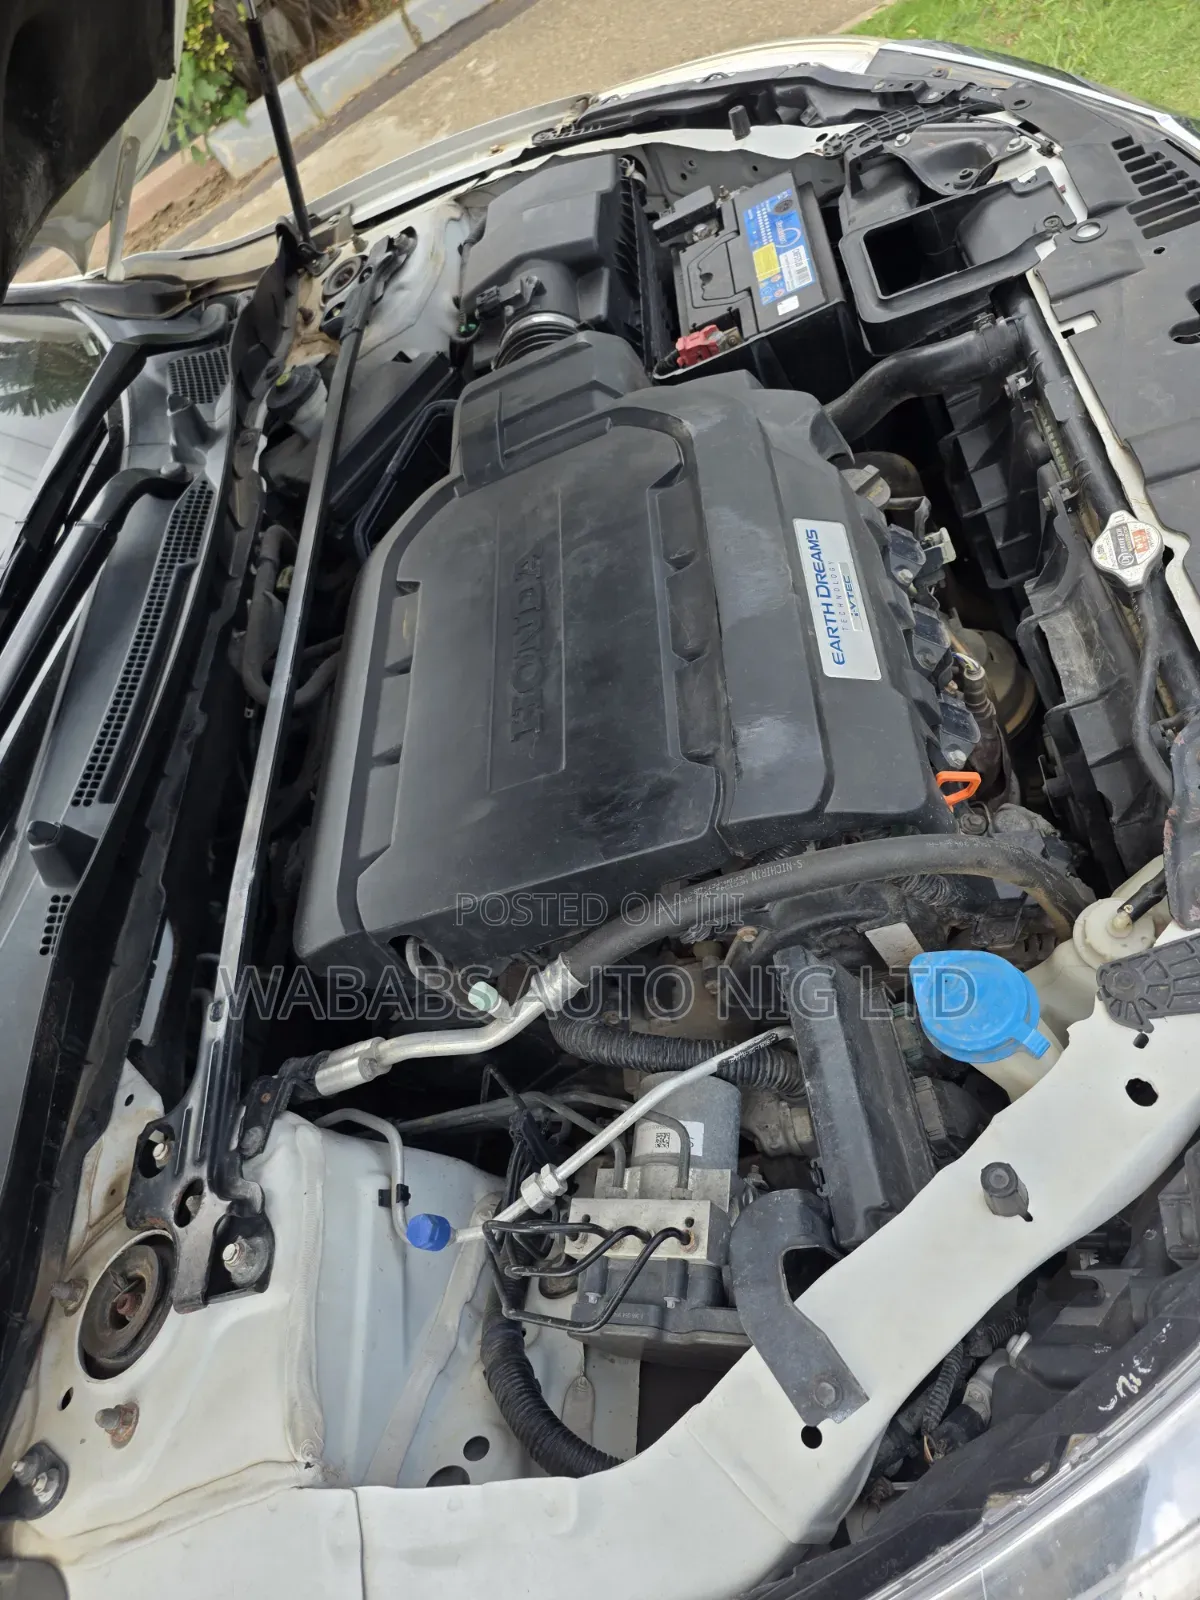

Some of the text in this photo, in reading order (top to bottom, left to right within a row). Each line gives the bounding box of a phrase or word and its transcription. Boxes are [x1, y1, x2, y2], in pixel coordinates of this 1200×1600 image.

[510, 545, 544, 743] HONDA
[805, 529, 846, 665] EARTH DREAMS
[828, 560, 849, 631] TECHNOLOGY
[751, 859, 803, 882] S-NICHIRIN
